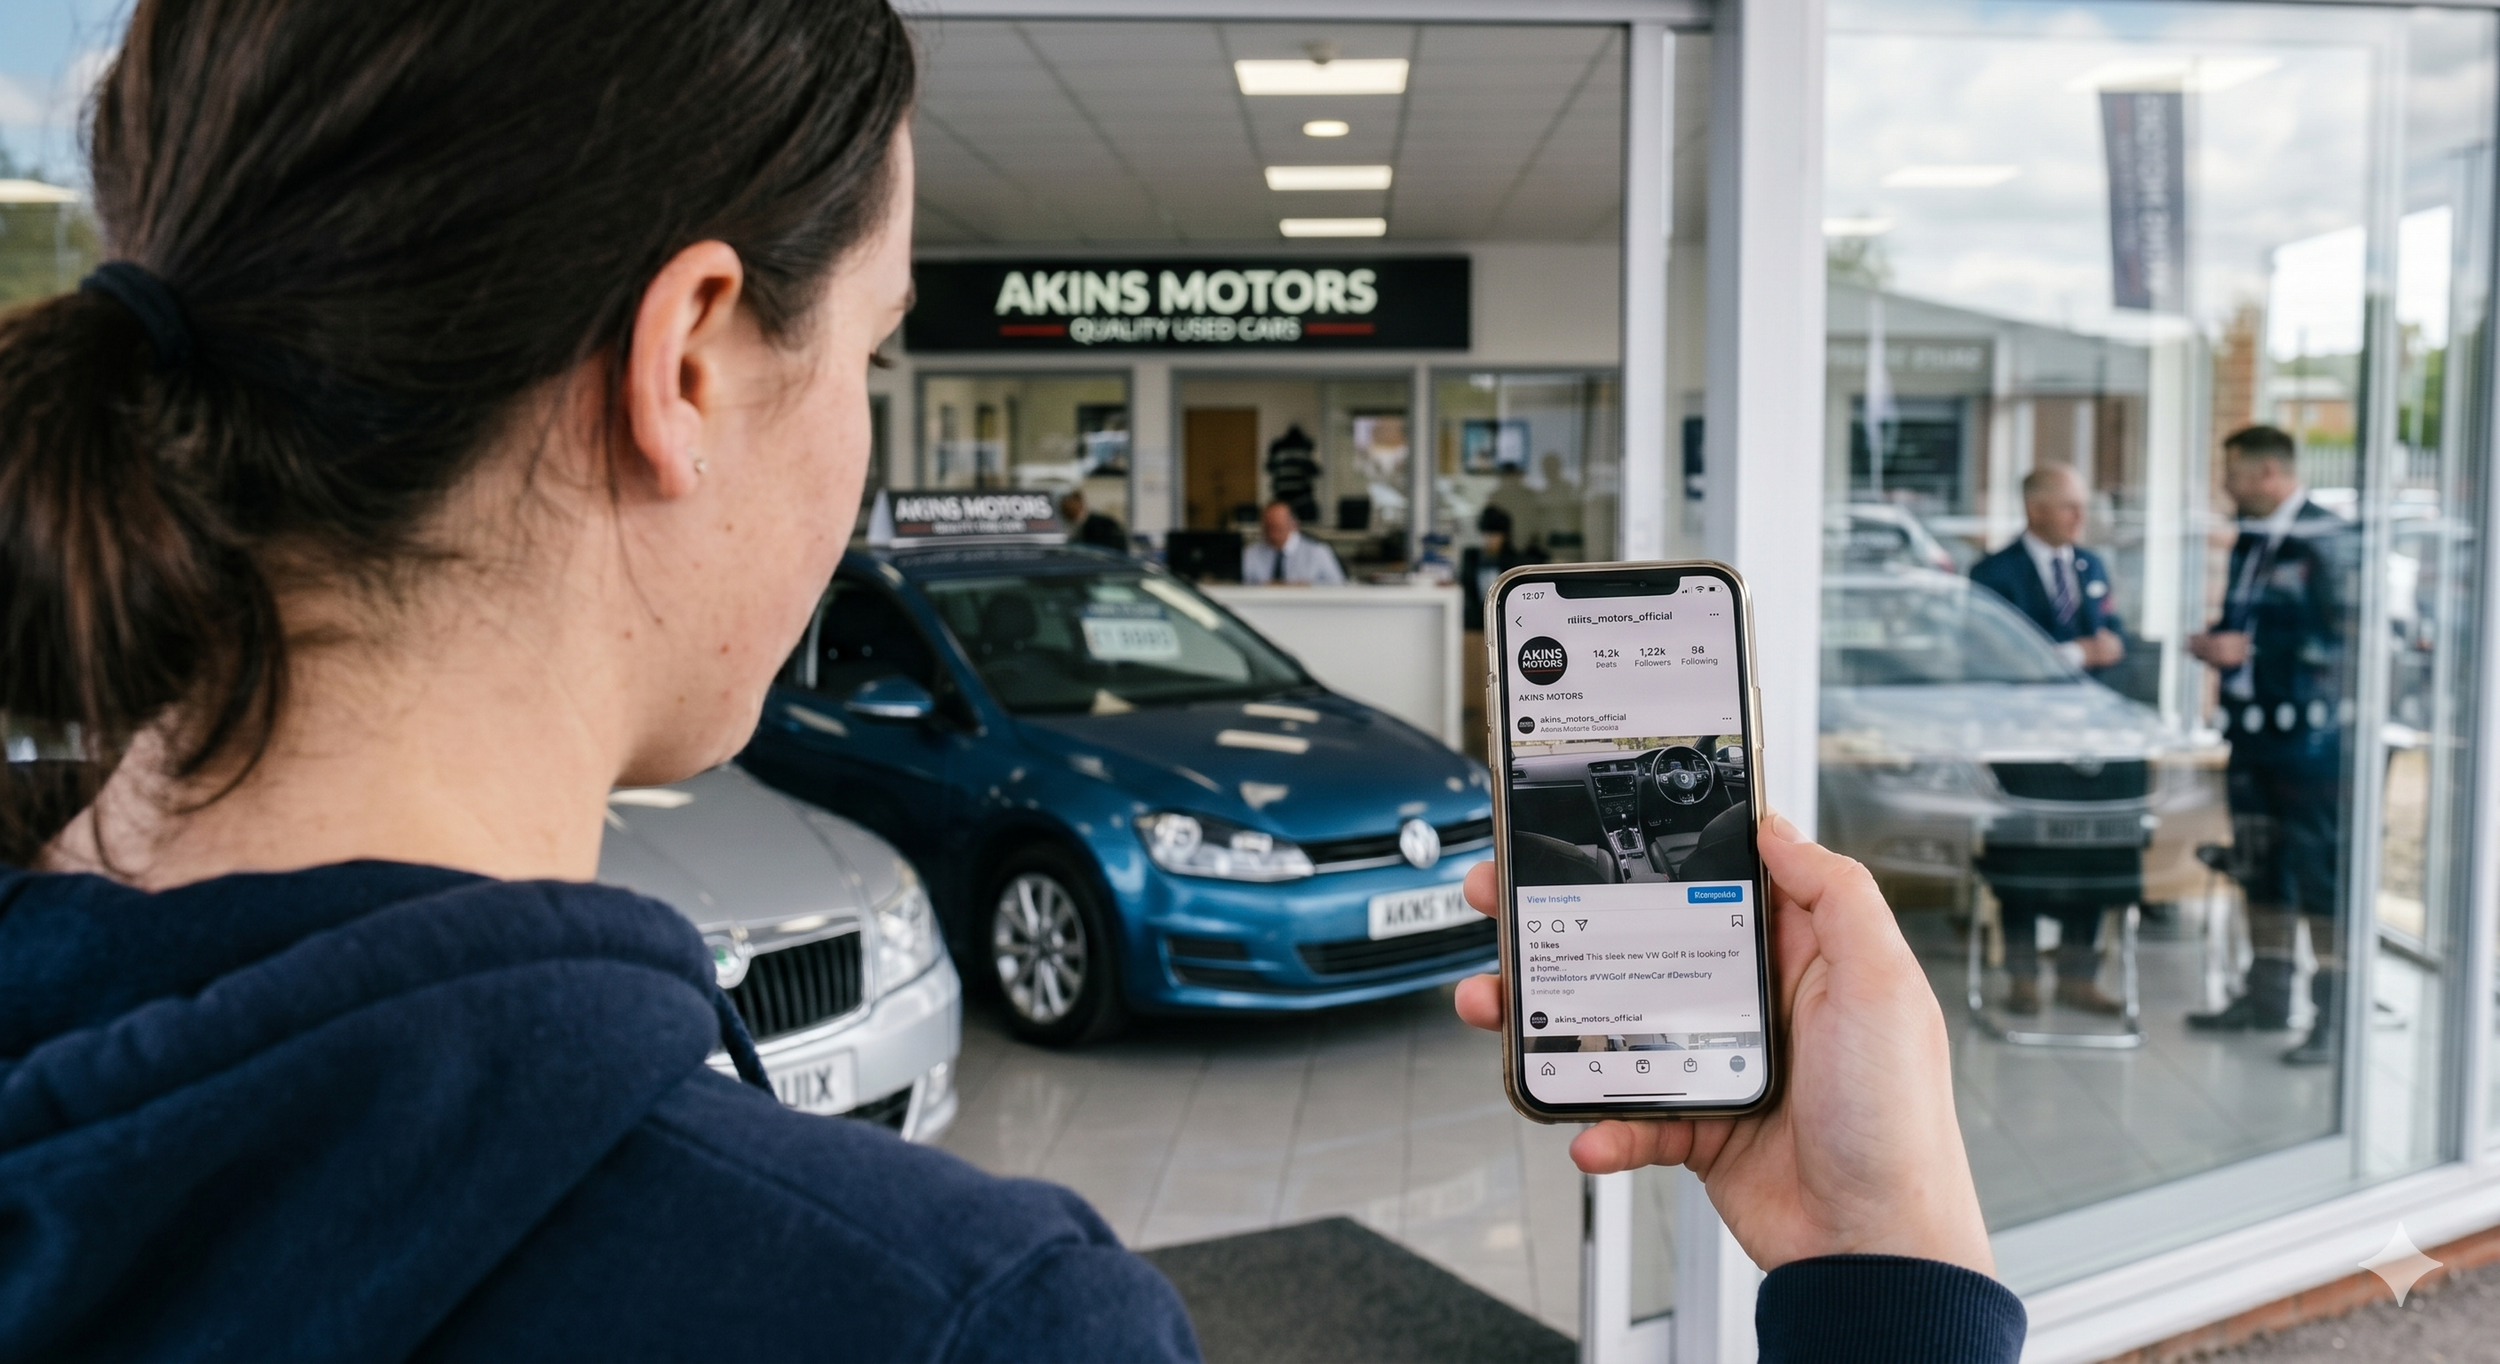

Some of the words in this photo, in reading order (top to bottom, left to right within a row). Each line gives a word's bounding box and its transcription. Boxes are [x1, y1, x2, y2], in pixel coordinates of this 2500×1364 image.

[996, 270, 1150, 315] AKINS
[1159, 269, 1378, 315] MOTORS
[1070, 316, 1168, 343] QUALITY
[1172, 316, 1237, 341] USED
[1238, 316, 1301, 341] CARS
[1521, 591, 1545, 600] 12:07
[1522, 648, 1563, 660] AKINS
[1593, 649, 1620, 659] 14.2k
[1639, 647, 1666, 657] 1,22k
[1522, 659, 1563, 669] MOTORS
[1634, 659, 1671, 667] Followers
[1681, 657, 1718, 666] Following
[1519, 693, 1545, 702] AKINS
[1546, 692, 1583, 701] MOTORS
[1540, 714, 1627, 724] akins_motors_official
[1548, 895, 1581, 904] Insights
[1541, 941, 1560, 949] likes
[1605, 952, 1625, 960] sleek
[1662, 951, 1679, 959] Golf
[1696, 950, 1726, 959] looking
[1728, 949, 1740, 957] for
[1589, 973, 1626, 981] #VWGolf
[1628, 972, 1665, 980] #NewCar
[1667, 971, 1713, 980] #Dewsbury
[1554, 1013, 1643, 1024] akins_motors_official
